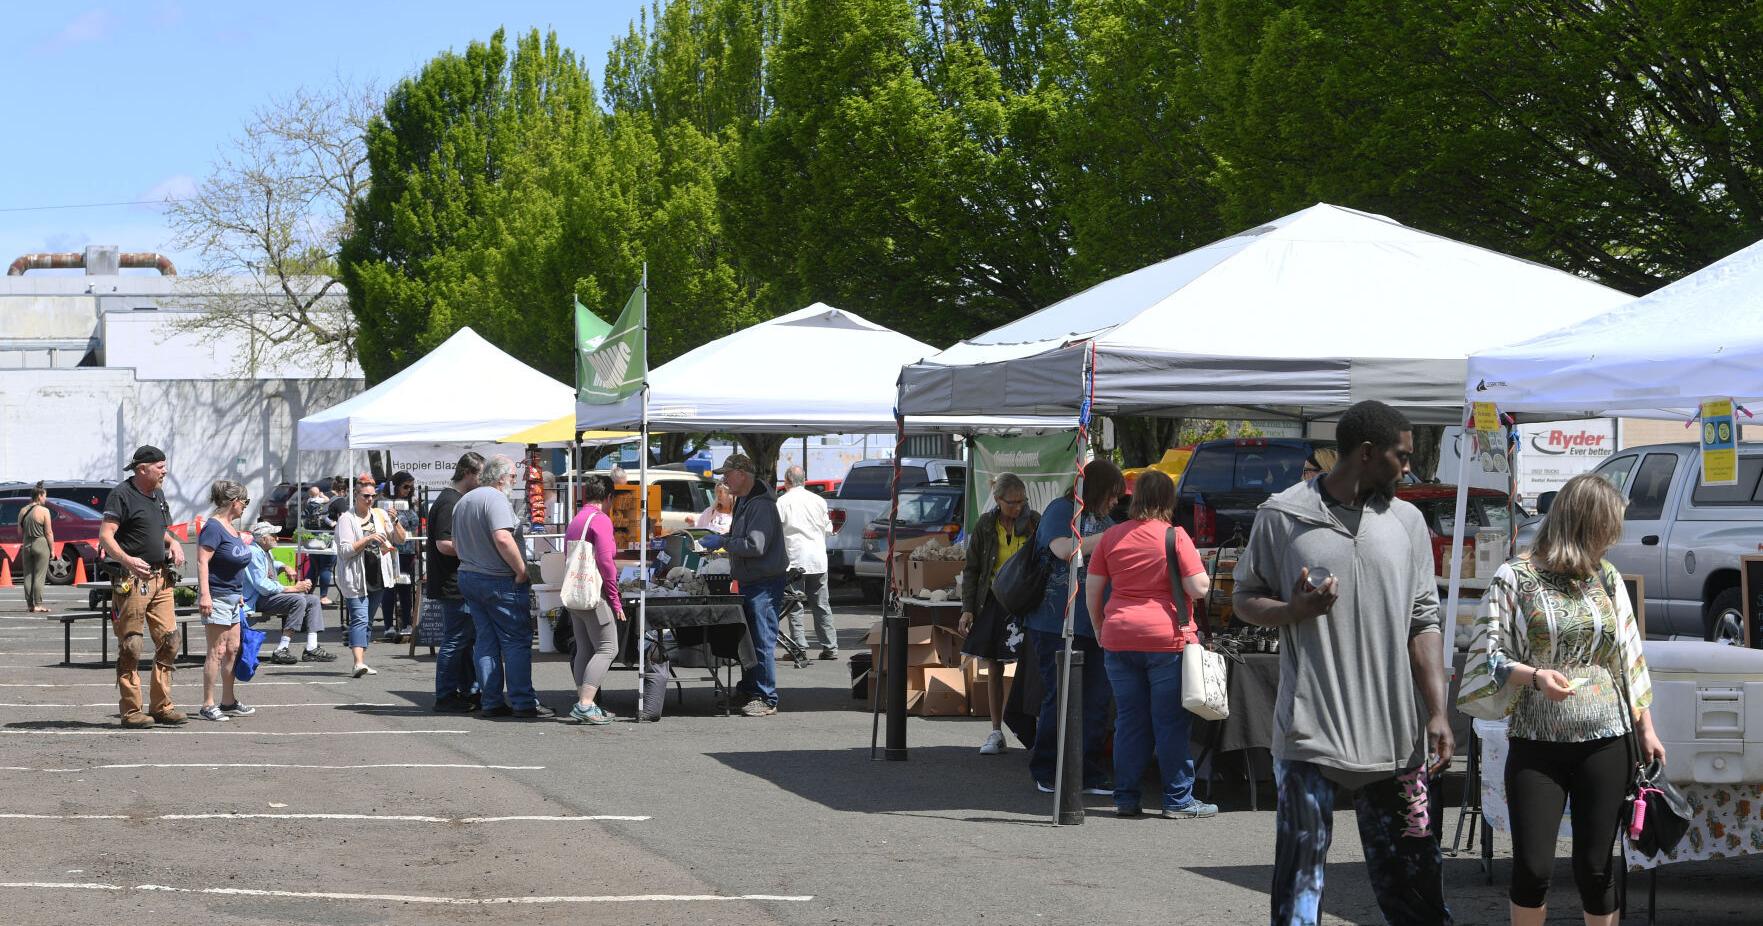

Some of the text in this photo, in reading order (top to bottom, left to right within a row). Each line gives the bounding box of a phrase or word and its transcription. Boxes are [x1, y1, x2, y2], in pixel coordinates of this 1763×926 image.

[1548, 429, 1605, 449] Ryder
[1569, 447, 1612, 455] Ever better
[392, 461, 431, 471] Happier
[434, 461, 457, 470] Blaz
